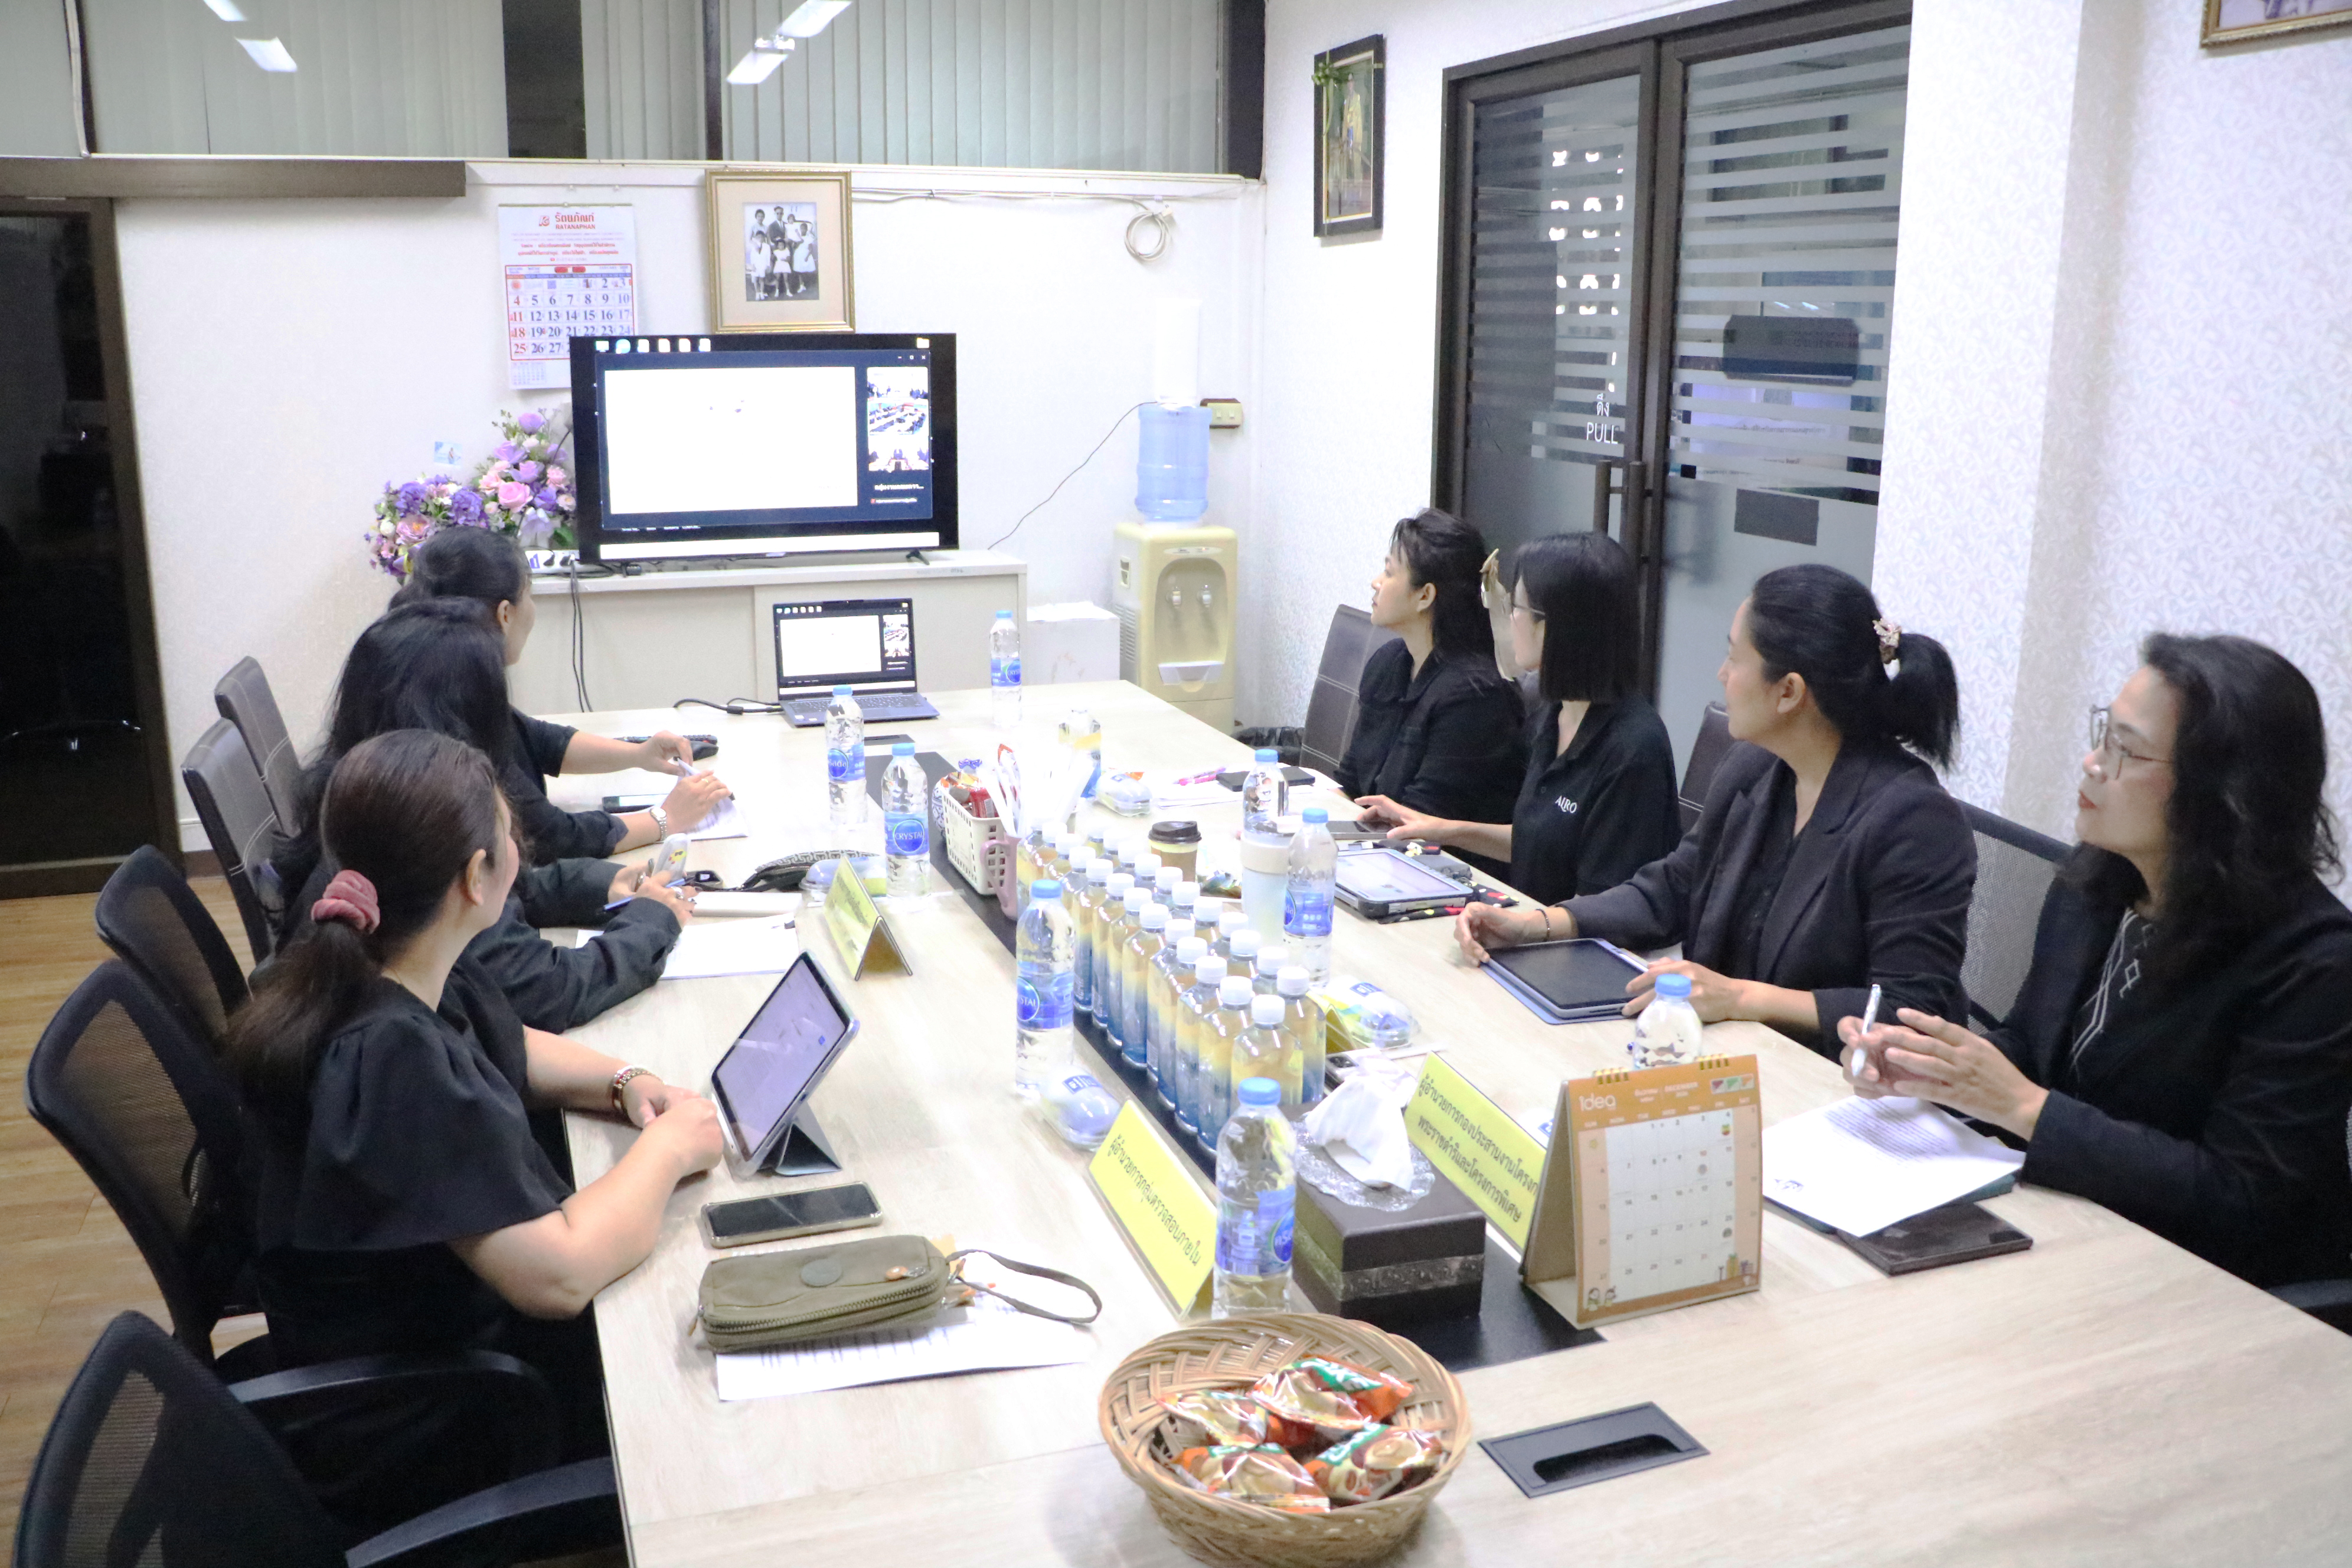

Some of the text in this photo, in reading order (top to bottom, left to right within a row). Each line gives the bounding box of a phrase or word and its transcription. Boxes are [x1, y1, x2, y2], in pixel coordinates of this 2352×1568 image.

[602, 279, 607, 288] 2
[514, 294, 629, 305] 4 5 6 7 8 9 10
[513, 310, 629, 321] 11 12 13 14 15 16 17
[514, 325, 631, 338] 18 19 20 21 22 23 24
[514, 343, 561, 354] 25 26 27
[1596, 393, 1610, 416] ดึง
[1586, 422, 1618, 445] PULL
[1555, 795, 1577, 814] ALRO
[1418, 1115, 1522, 1223] พระราชดำริและโครงการพิเศษ
[1108, 1133, 1201, 1266] ผู้อำนวยการกลุ่มตรวจสอบภายใน
